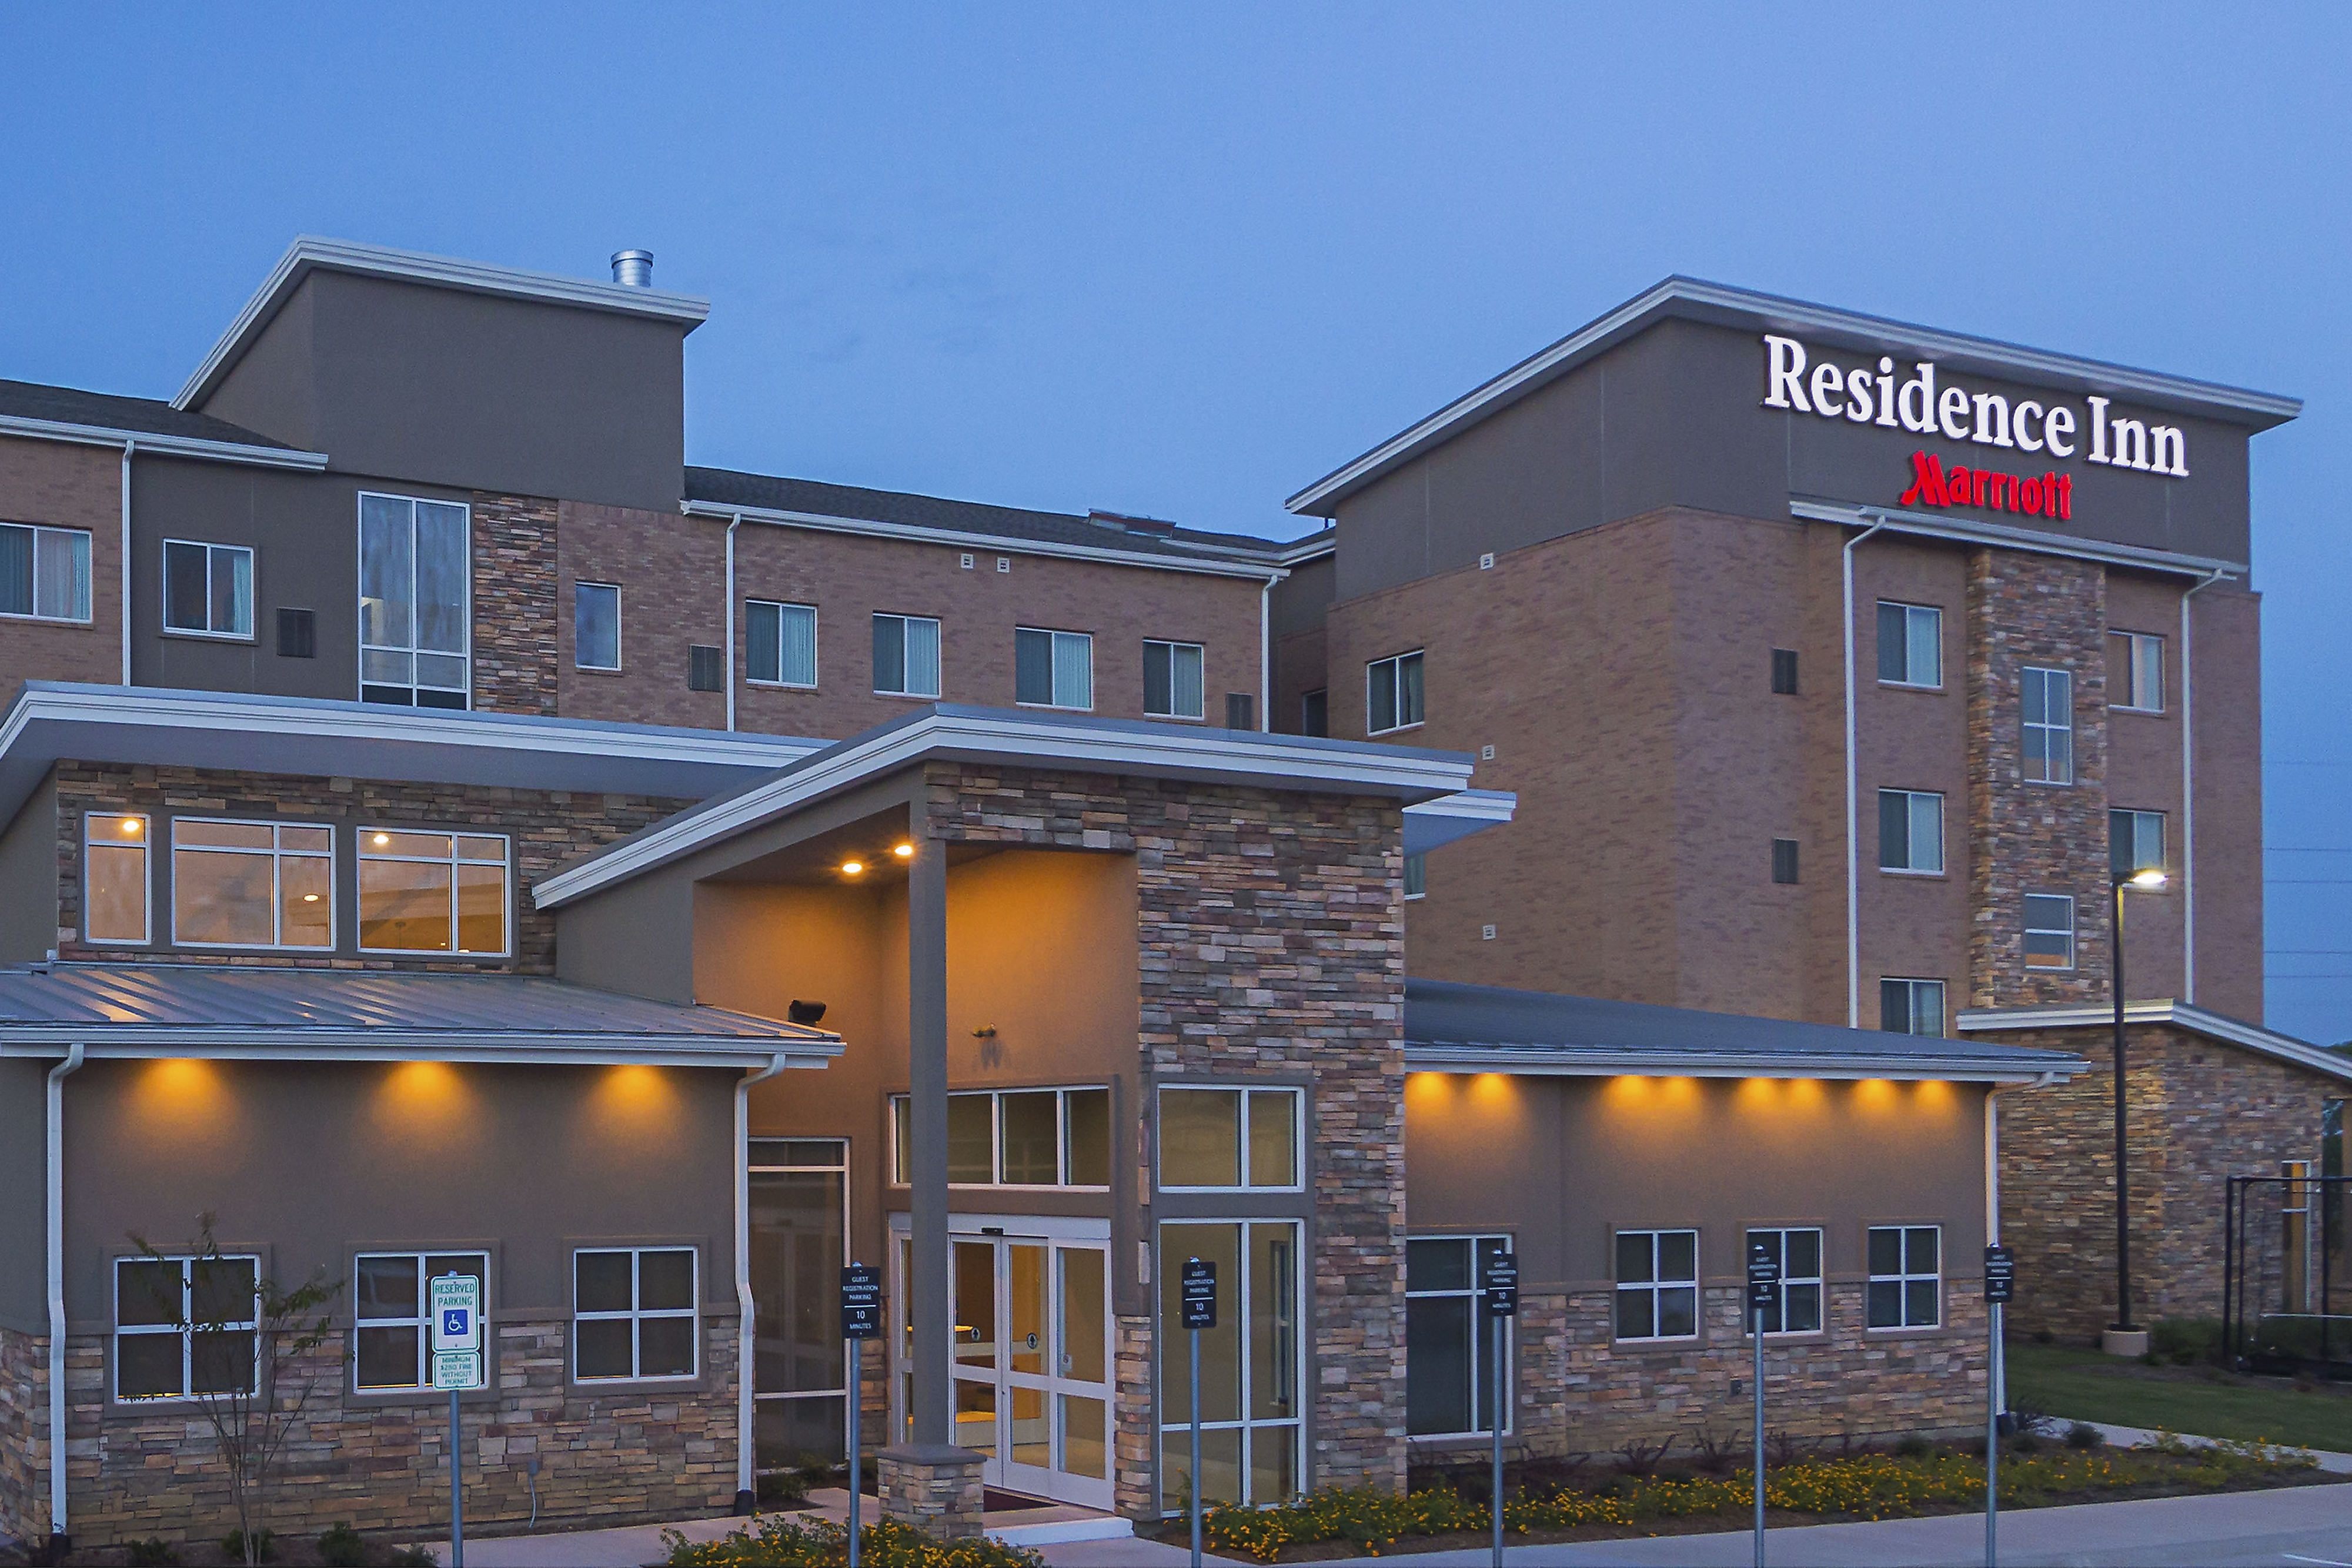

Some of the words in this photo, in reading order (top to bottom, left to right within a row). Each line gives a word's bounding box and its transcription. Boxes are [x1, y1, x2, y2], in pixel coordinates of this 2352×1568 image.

[1764, 334, 2076, 457] Residence
[2085, 395, 2190, 477] Inn
[1900, 450, 2073, 520] Marriott
[435, 1283, 475, 1294] RESERVED
[438, 1296, 473, 1307] PARKING
[856, 1310, 865, 1319] 10
